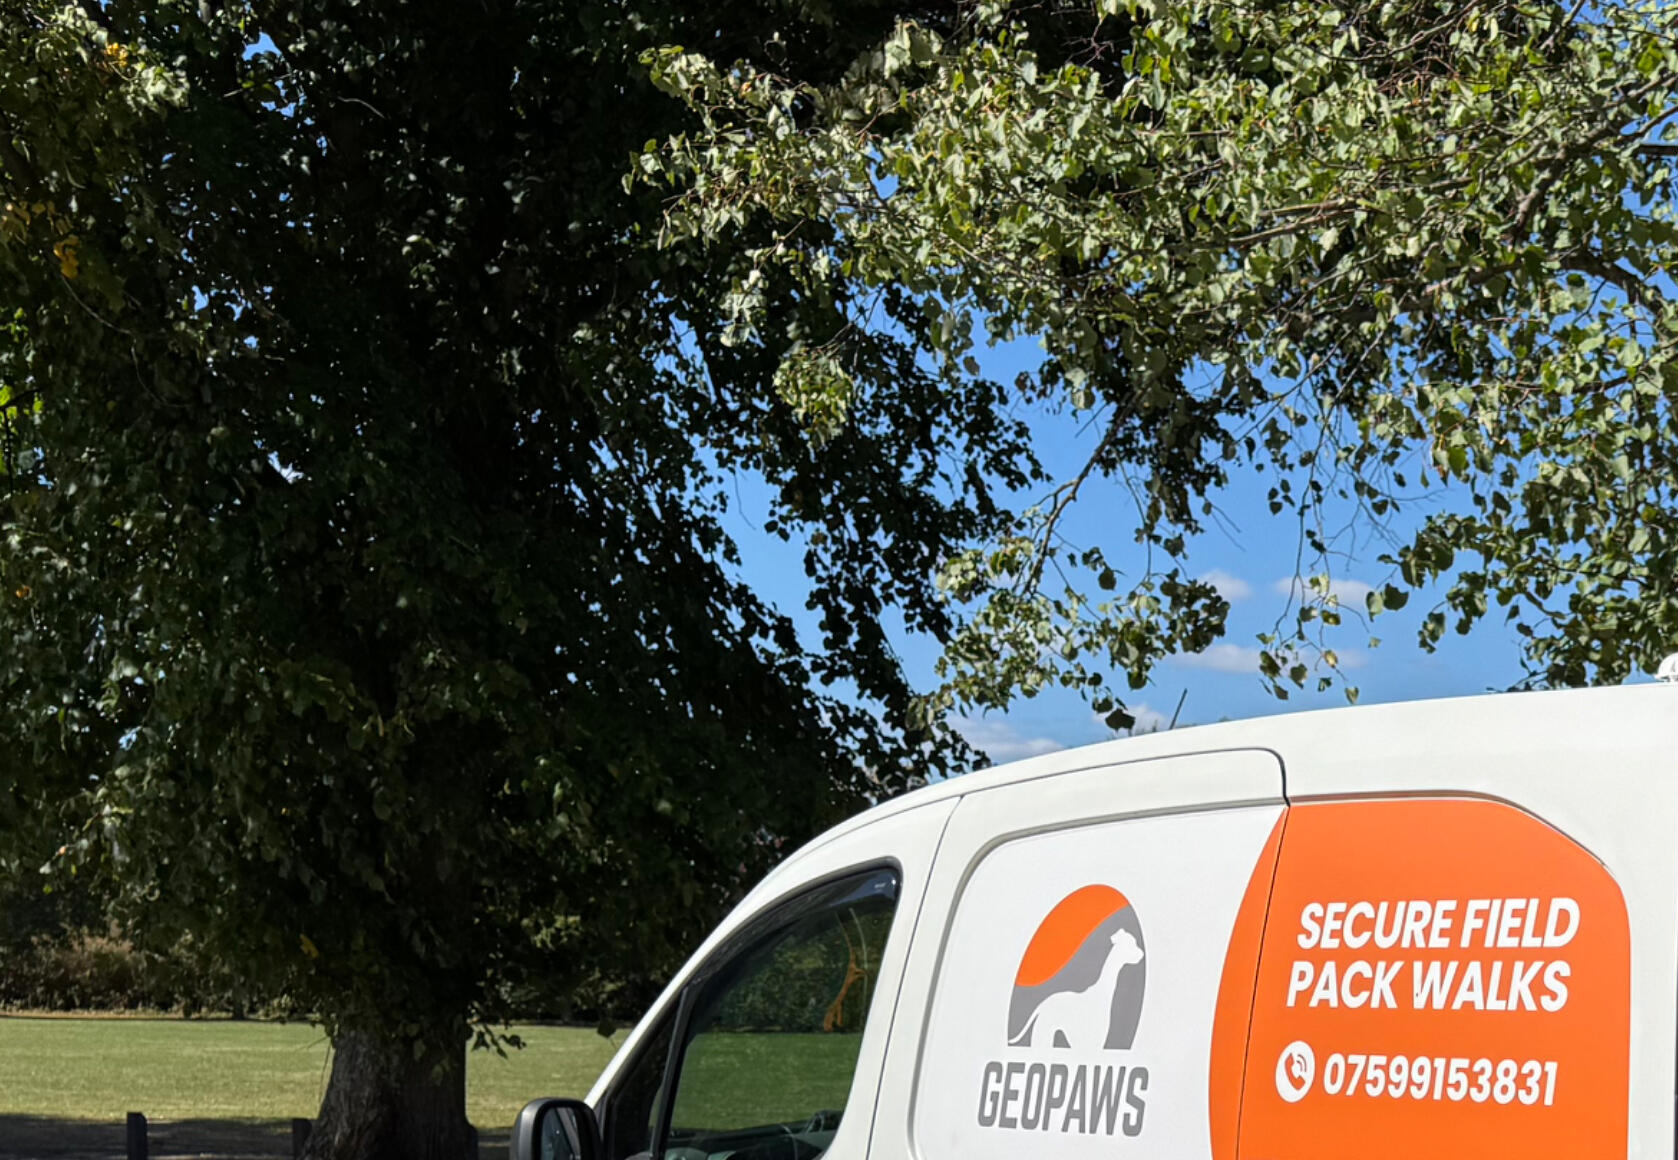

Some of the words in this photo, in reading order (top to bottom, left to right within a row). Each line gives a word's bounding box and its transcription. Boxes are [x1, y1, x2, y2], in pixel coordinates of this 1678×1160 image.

[1297, 899, 1456, 950] SECURE
[1460, 897, 1581, 948] FIELD
[1286, 960, 1402, 1009] PACK
[1410, 961, 1571, 1013] WALKS
[977, 1061, 1149, 1138] GEOPAWS
[1323, 1054, 1559, 1106] 07599153831
